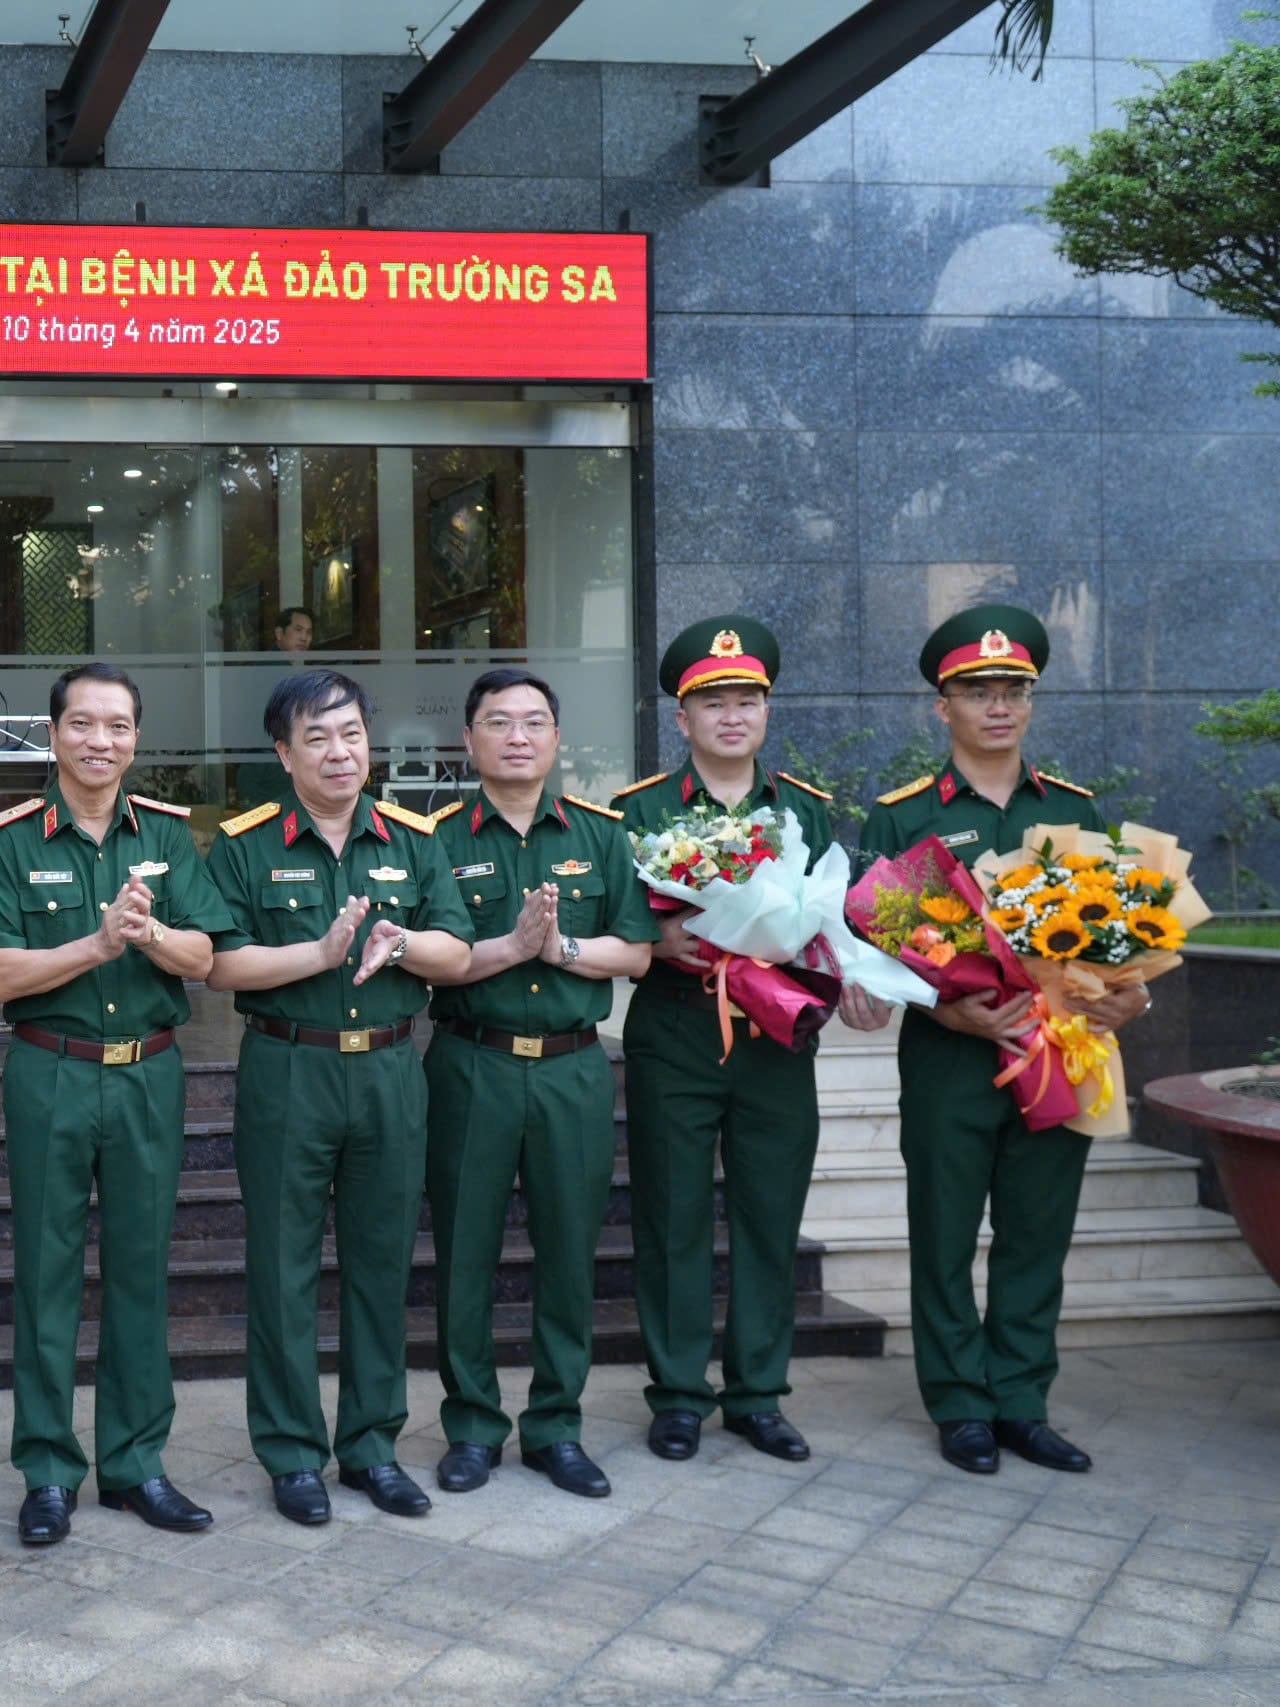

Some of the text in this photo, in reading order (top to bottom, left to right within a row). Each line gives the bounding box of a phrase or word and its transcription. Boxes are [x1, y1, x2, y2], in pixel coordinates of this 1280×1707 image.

[80, 248, 197, 309] BỆNH
[208, 250, 269, 297] XÁ
[283, 249, 369, 300] ĐẢO
[379, 255, 549, 303] TRƯỜNG
[560, 264, 618, 303] SA
[2, 315, 31, 341] 10
[39, 315, 117, 349] tháng
[123, 317, 141, 343] 4
[149, 317, 206, 344] năm
[213, 318, 281, 345] 2025
